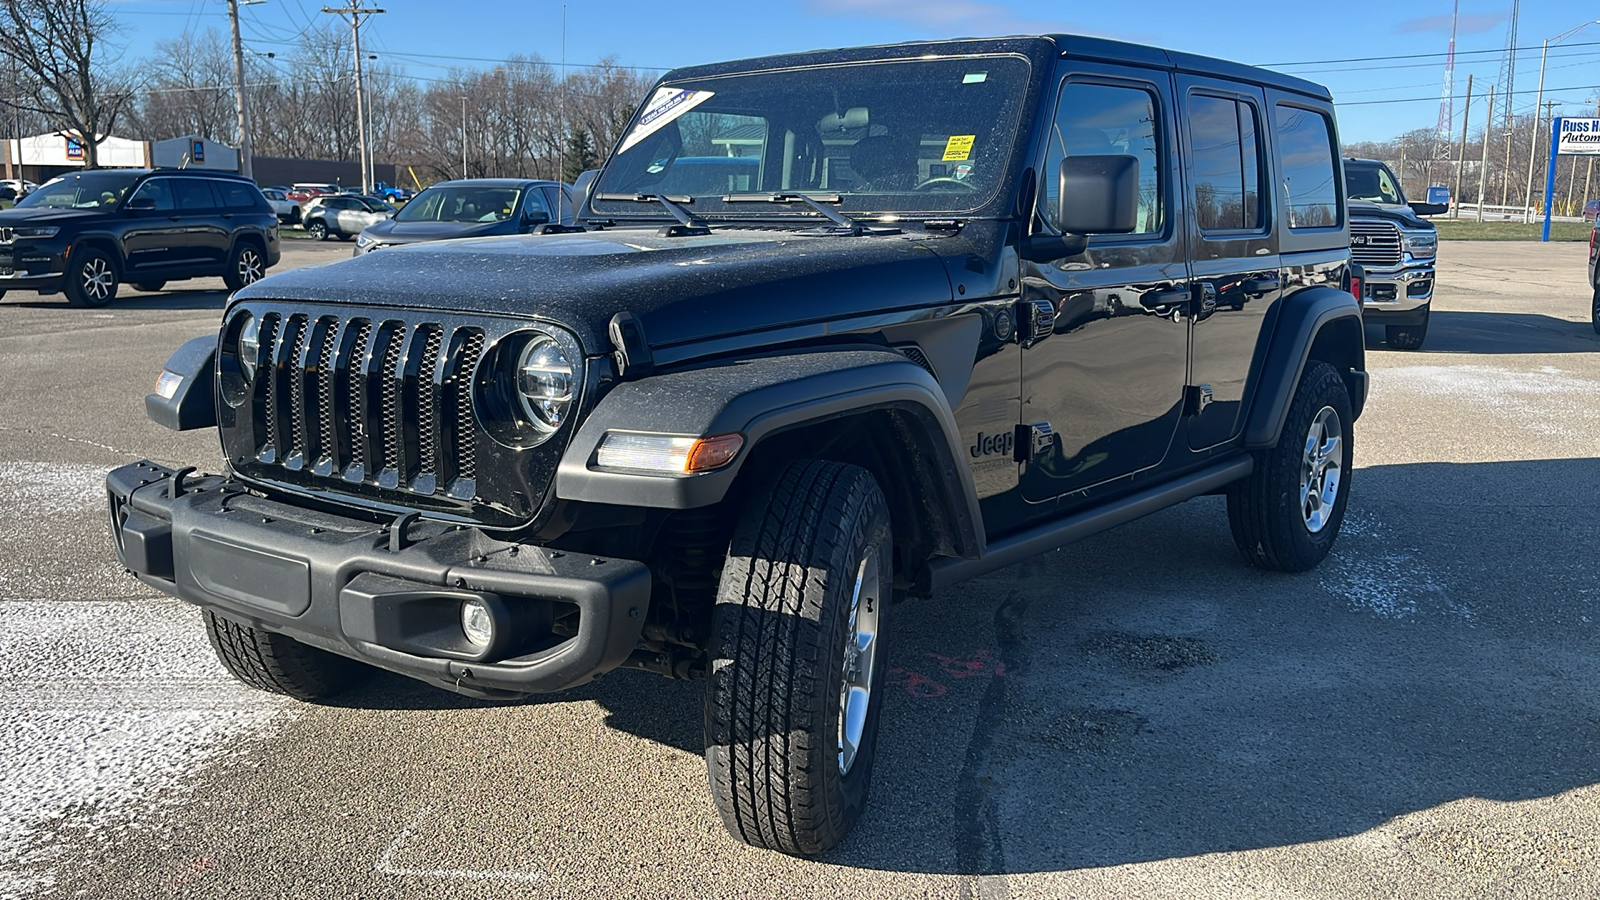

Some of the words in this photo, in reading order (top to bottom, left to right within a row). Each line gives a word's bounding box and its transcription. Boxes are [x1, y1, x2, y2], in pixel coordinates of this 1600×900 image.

[1562, 120, 1589, 132] Russ
[1592, 120, 1600, 132] H
[1561, 133, 1600, 143] Autom
[970, 431, 1014, 458] Jeep
